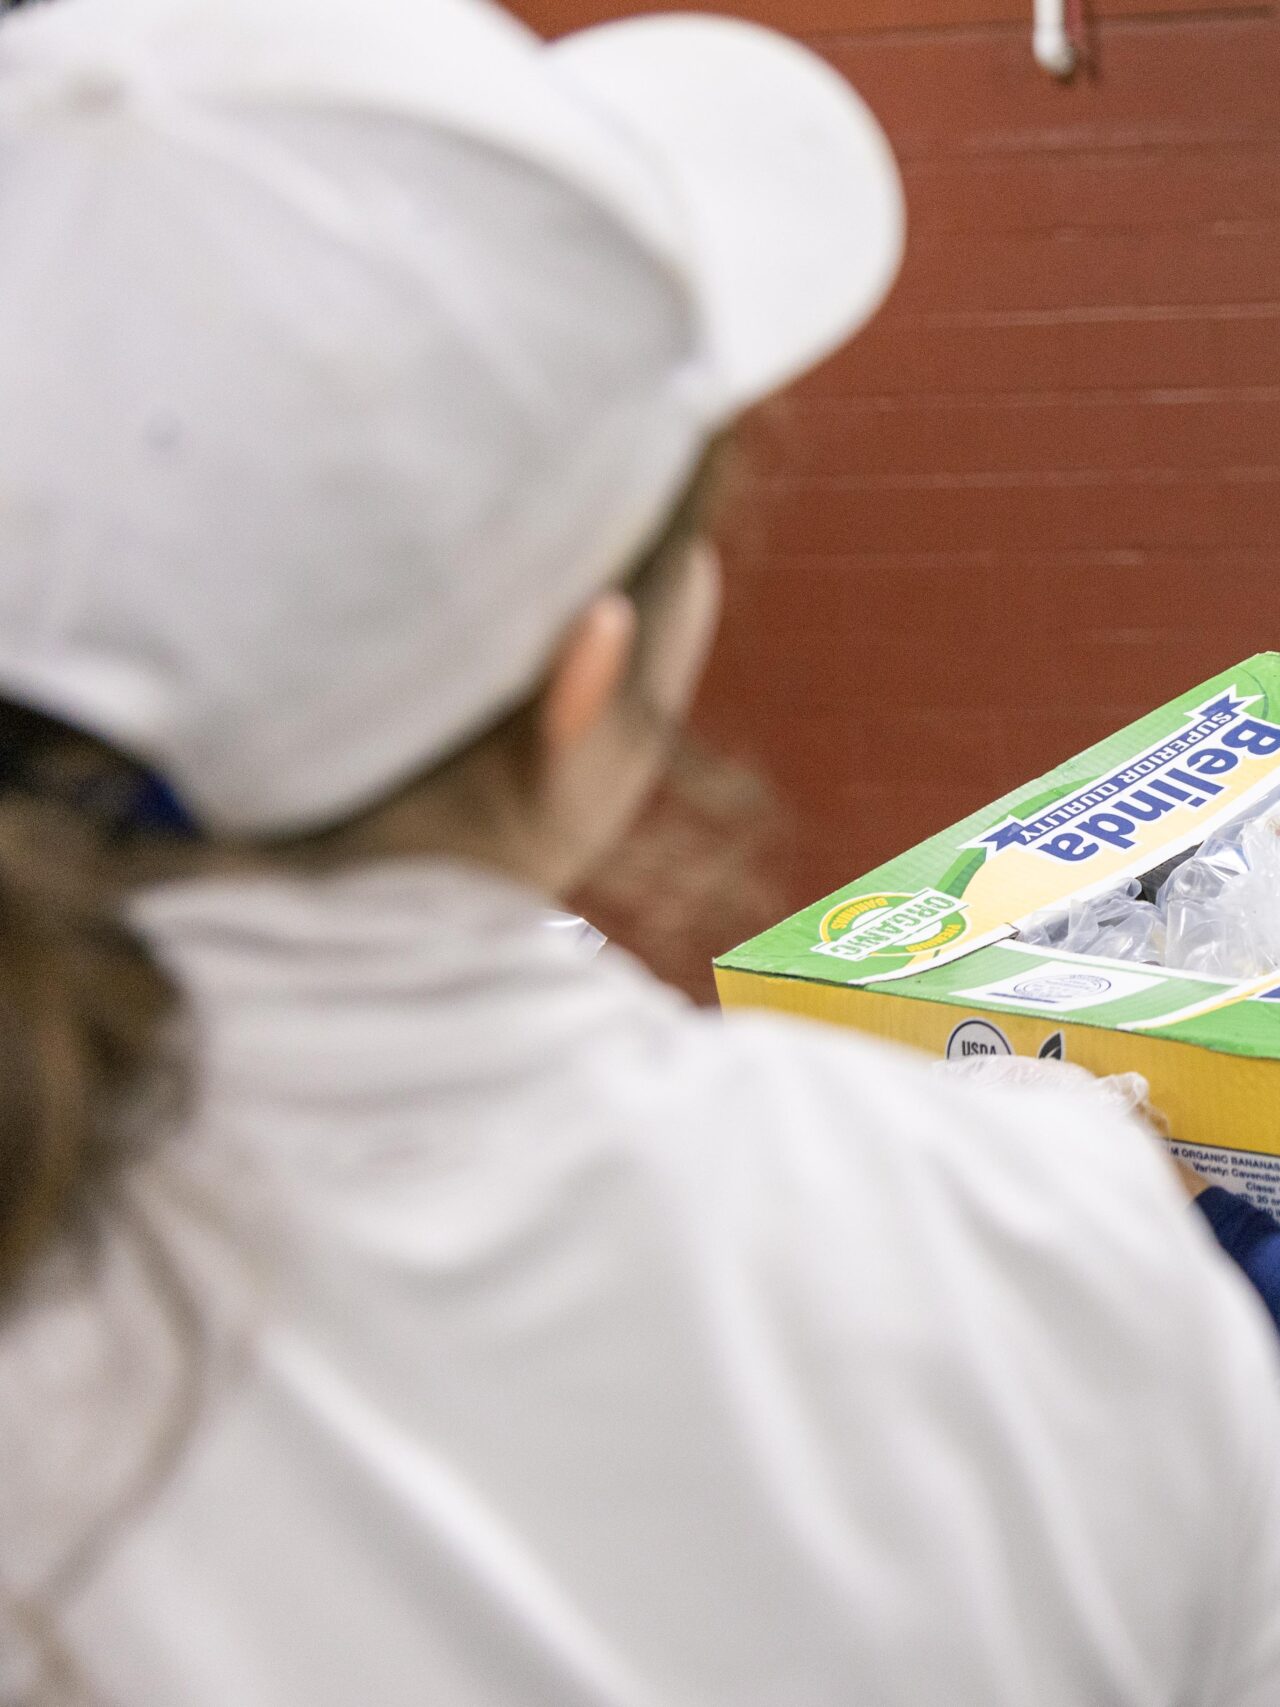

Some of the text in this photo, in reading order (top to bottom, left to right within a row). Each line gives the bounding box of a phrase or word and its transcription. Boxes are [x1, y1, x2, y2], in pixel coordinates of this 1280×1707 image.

[1020, 711, 1232, 842] SUPERIOR QUALITY
[830, 895, 956, 956] ORGANIC
[1181, 1149, 1229, 1164] ORGANIC
[1231, 1157, 1280, 1172] BANANAS
